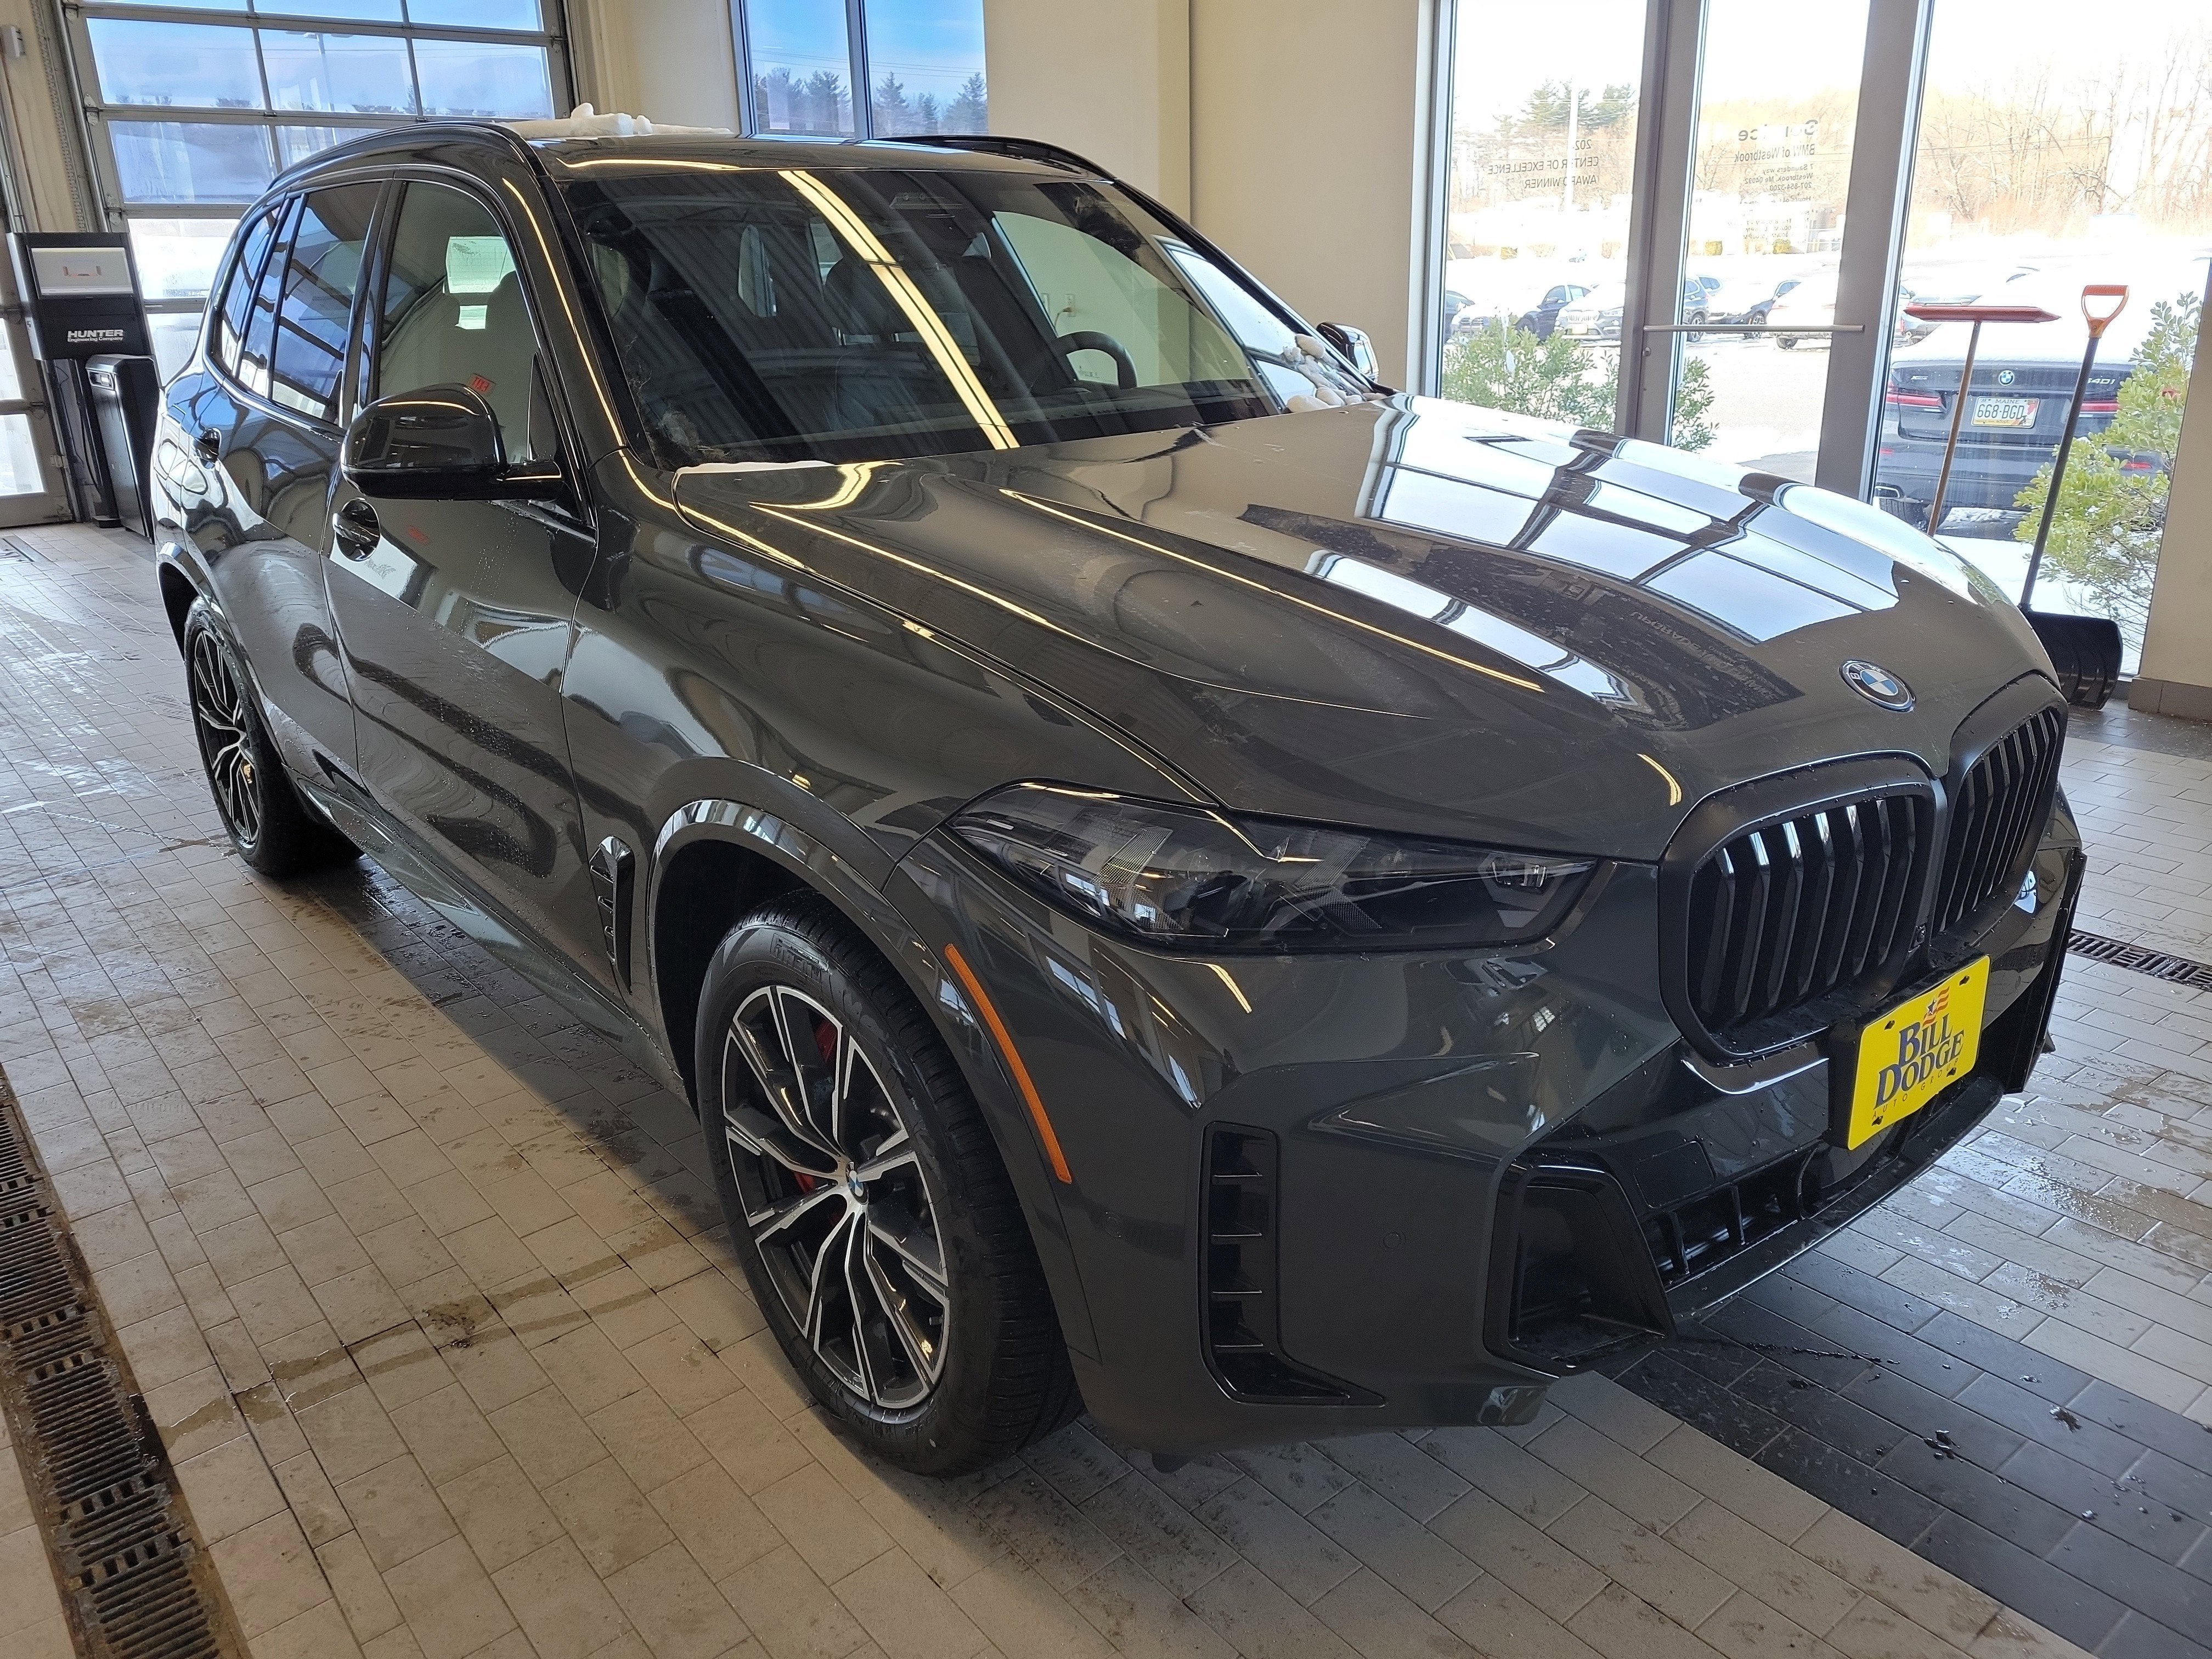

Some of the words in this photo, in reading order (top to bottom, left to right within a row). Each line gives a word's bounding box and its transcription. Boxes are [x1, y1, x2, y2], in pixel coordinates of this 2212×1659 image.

[68, 329, 123, 337] HUNTER
[1872, 1093, 1908, 1119] AUTO
[1921, 1058, 1959, 1091] GROUP
[1874, 1029, 1965, 1110] DODGE
